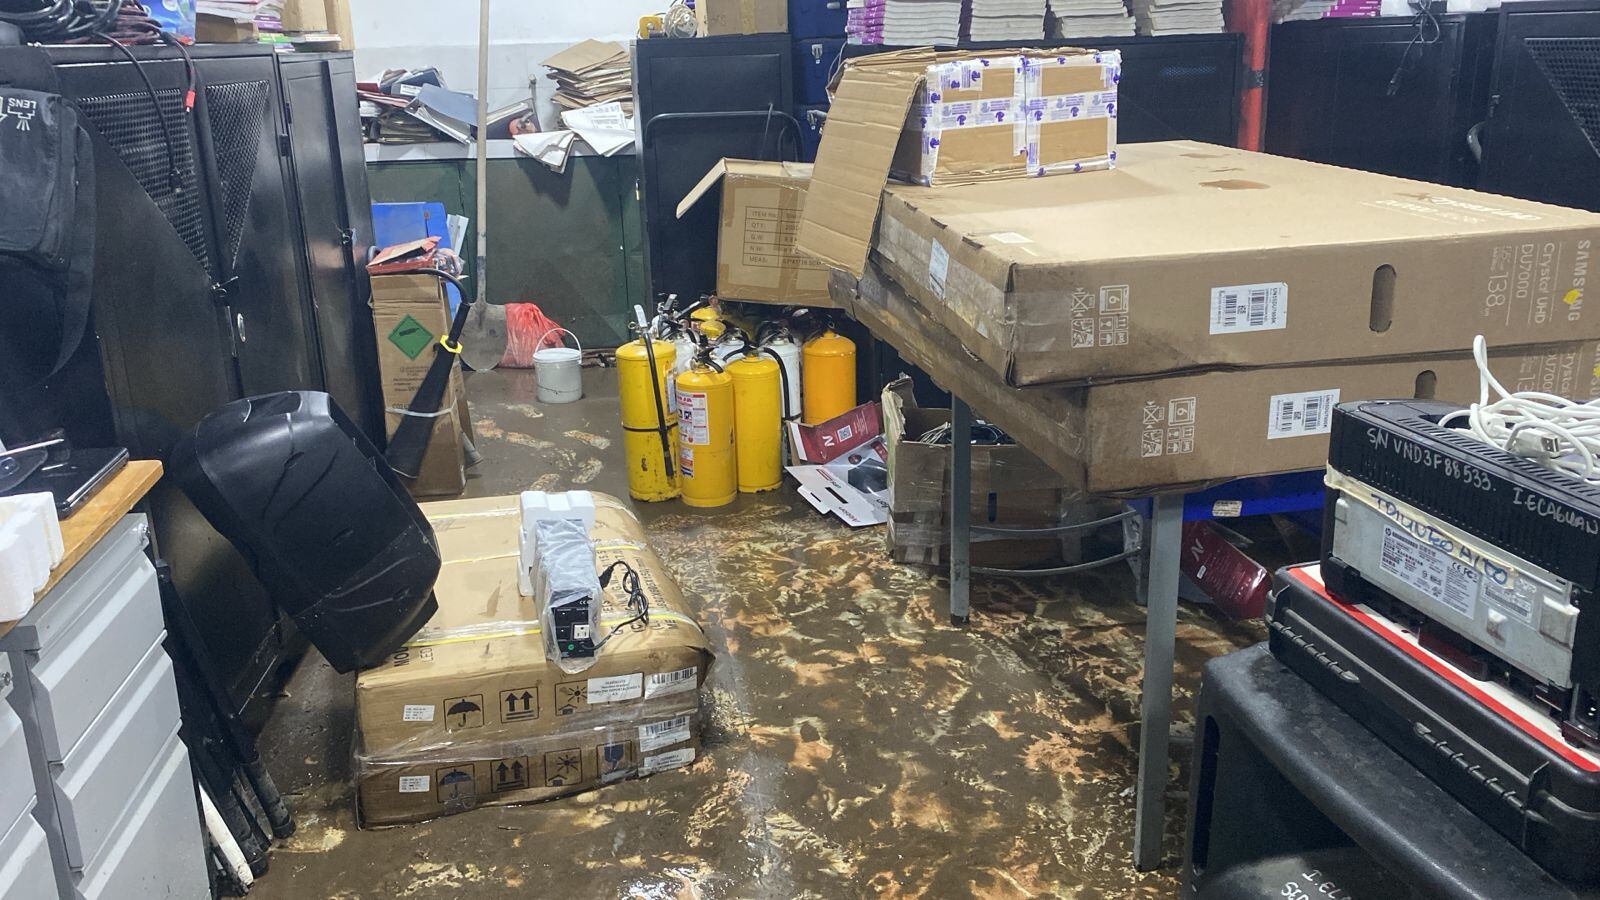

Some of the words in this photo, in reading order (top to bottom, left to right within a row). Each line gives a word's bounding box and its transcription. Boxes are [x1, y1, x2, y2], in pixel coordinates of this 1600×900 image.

[8, 97, 37, 109] LENS
[1515, 243, 1534, 299] DU7000
[1538, 242, 1556, 293] Crystal
[1486, 272, 1509, 307] 138
[1534, 296, 1549, 324] UHD
[1542, 352, 1558, 395] U700
[1561, 349, 1577, 400] rysta
[1366, 427, 1389, 450] S/N
